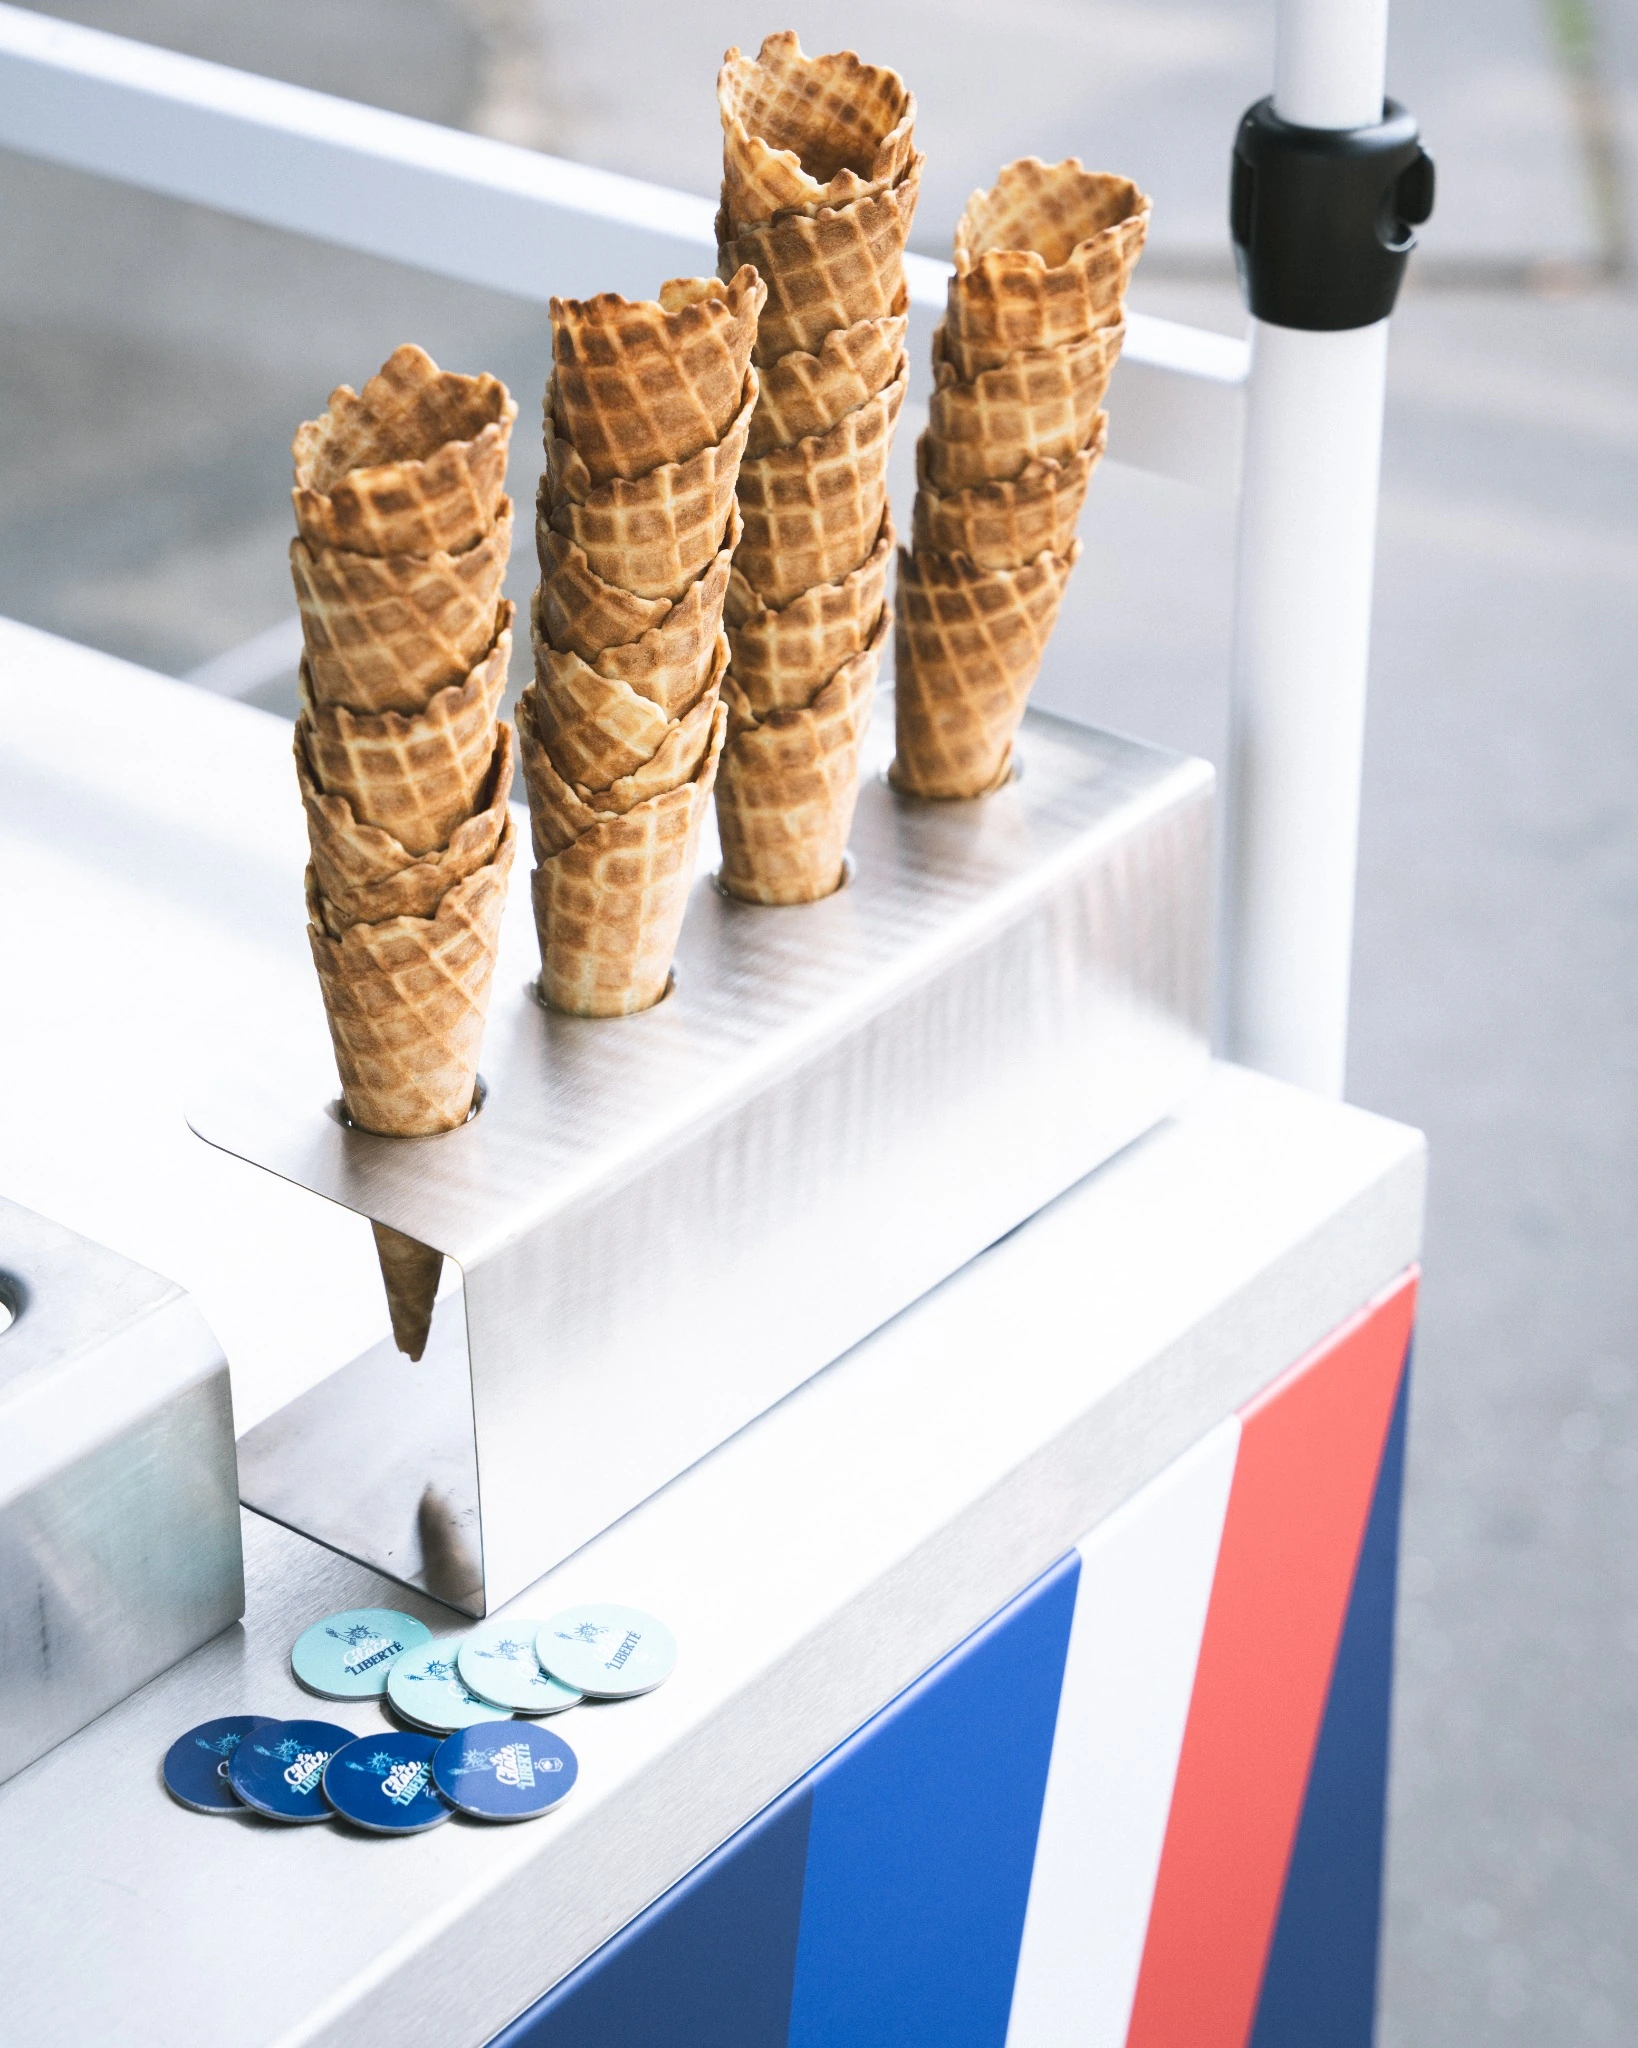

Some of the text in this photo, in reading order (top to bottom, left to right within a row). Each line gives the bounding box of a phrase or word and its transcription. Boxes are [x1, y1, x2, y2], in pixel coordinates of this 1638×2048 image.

[343, 1638, 392, 1666] Glace
[350, 1641, 404, 1675] LIBERTÉ
[609, 1630, 642, 1670] LIBERTÉ
[284, 1751, 329, 1785] Glace
[381, 1761, 421, 1797] Glace
[515, 1743, 536, 1787] LIBERTÉ
